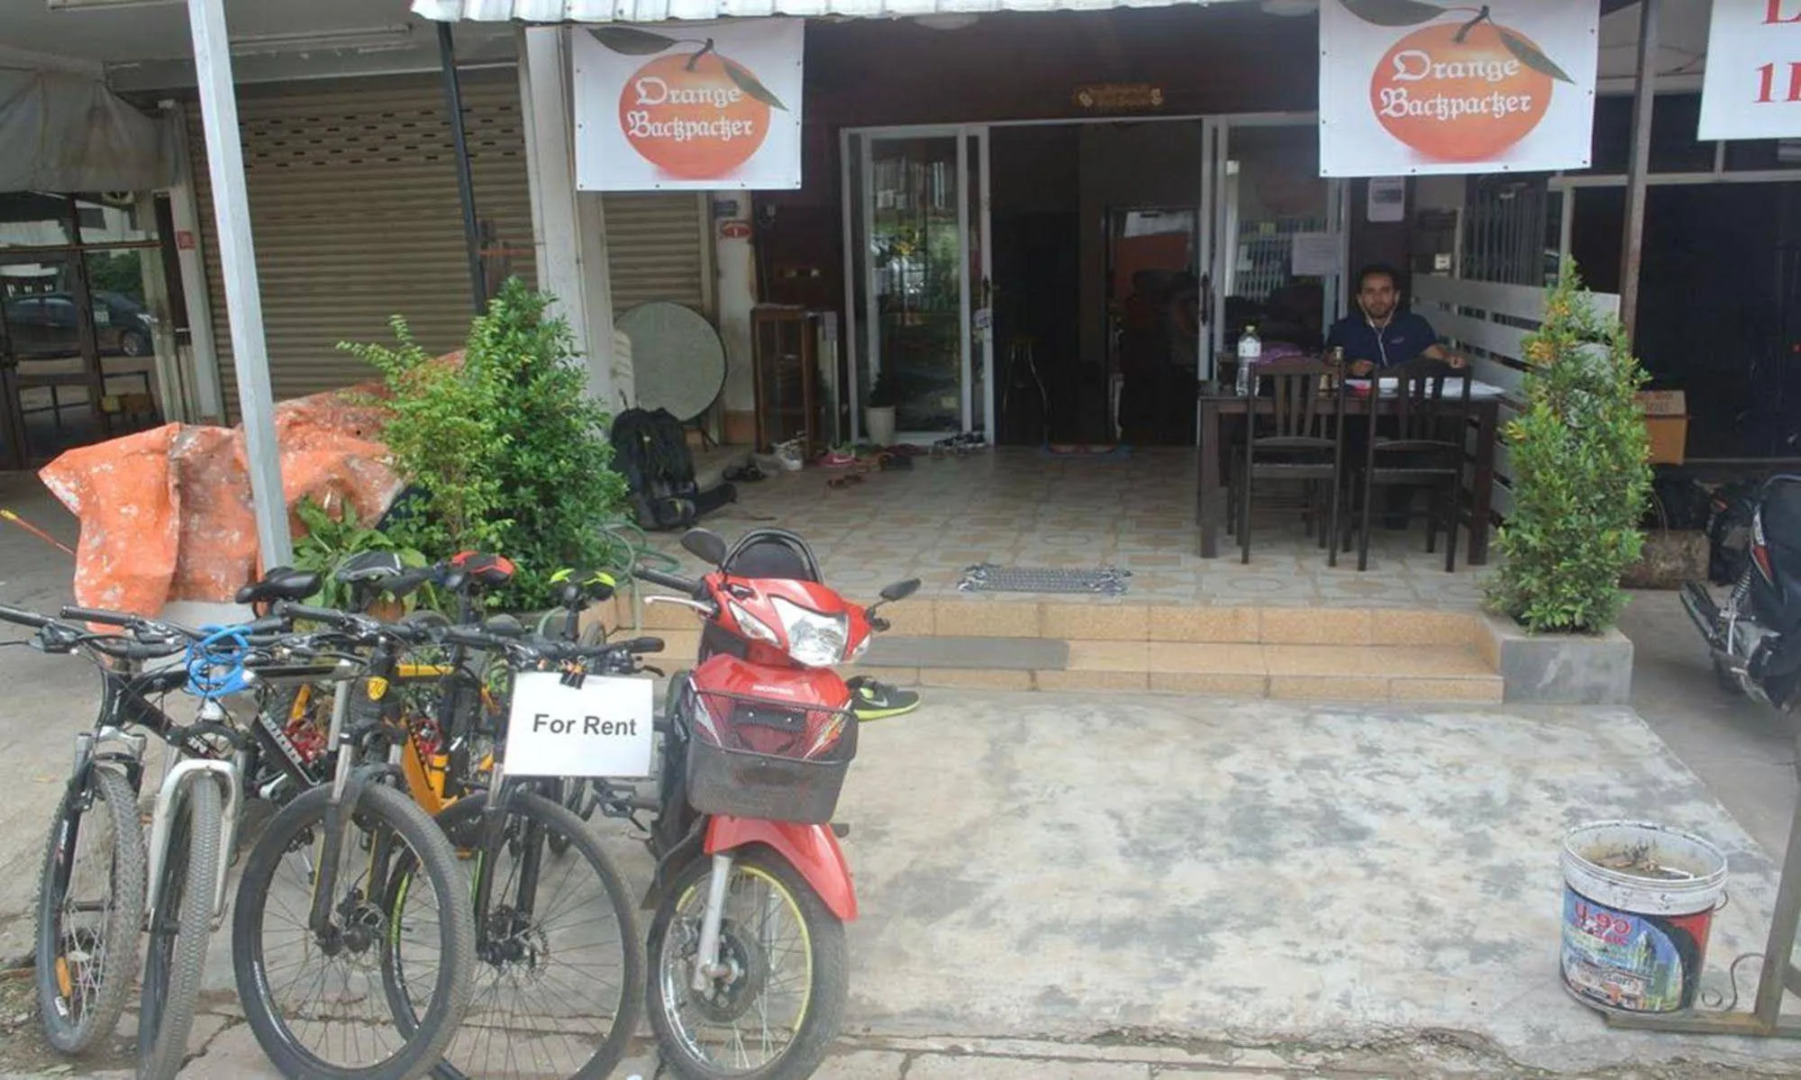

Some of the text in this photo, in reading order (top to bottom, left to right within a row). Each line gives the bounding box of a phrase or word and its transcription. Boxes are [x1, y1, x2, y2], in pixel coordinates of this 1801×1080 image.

[1392, 50, 1521, 82] Orange
[635, 76, 742, 108] Orange
[1380, 87, 1532, 121] Backpacker
[627, 110, 753, 142] Backpacker
[533, 713, 637, 736] For Rent
